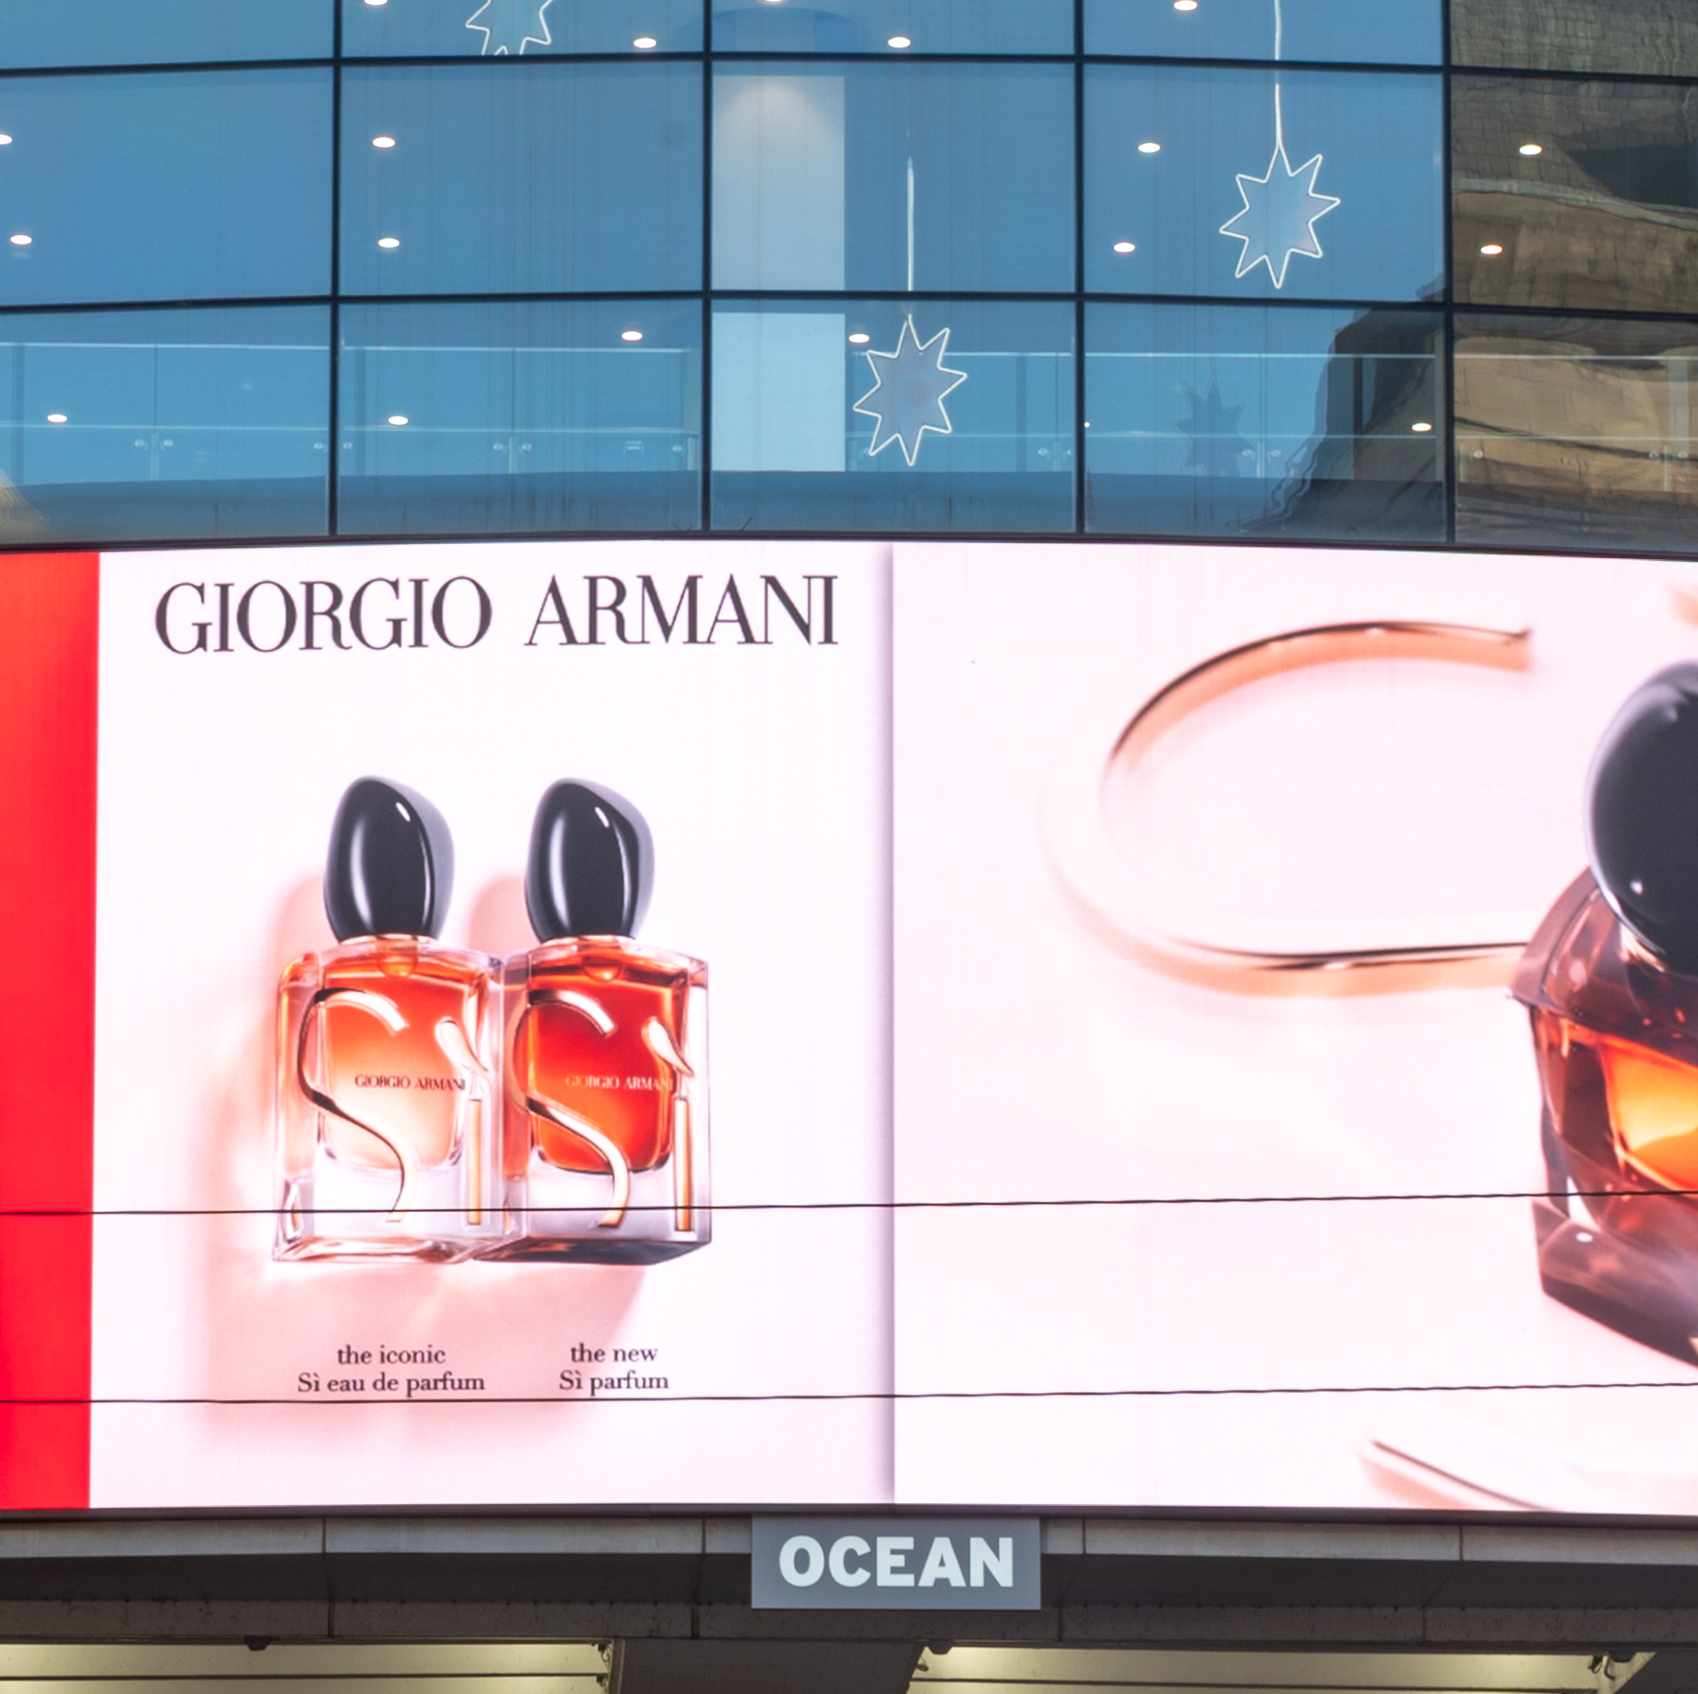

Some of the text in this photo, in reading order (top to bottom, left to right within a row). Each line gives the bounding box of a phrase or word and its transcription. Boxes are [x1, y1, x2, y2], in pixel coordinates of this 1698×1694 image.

[154, 574, 838, 655] GIORGIO ARMANI
[337, 1345, 446, 1365] the iconic
[570, 1342, 658, 1363] the new
[297, 1371, 485, 1398] Sì eau de parfum
[559, 1370, 669, 1396] Sì parfum
[779, 1535, 1013, 1587] OCEAN
